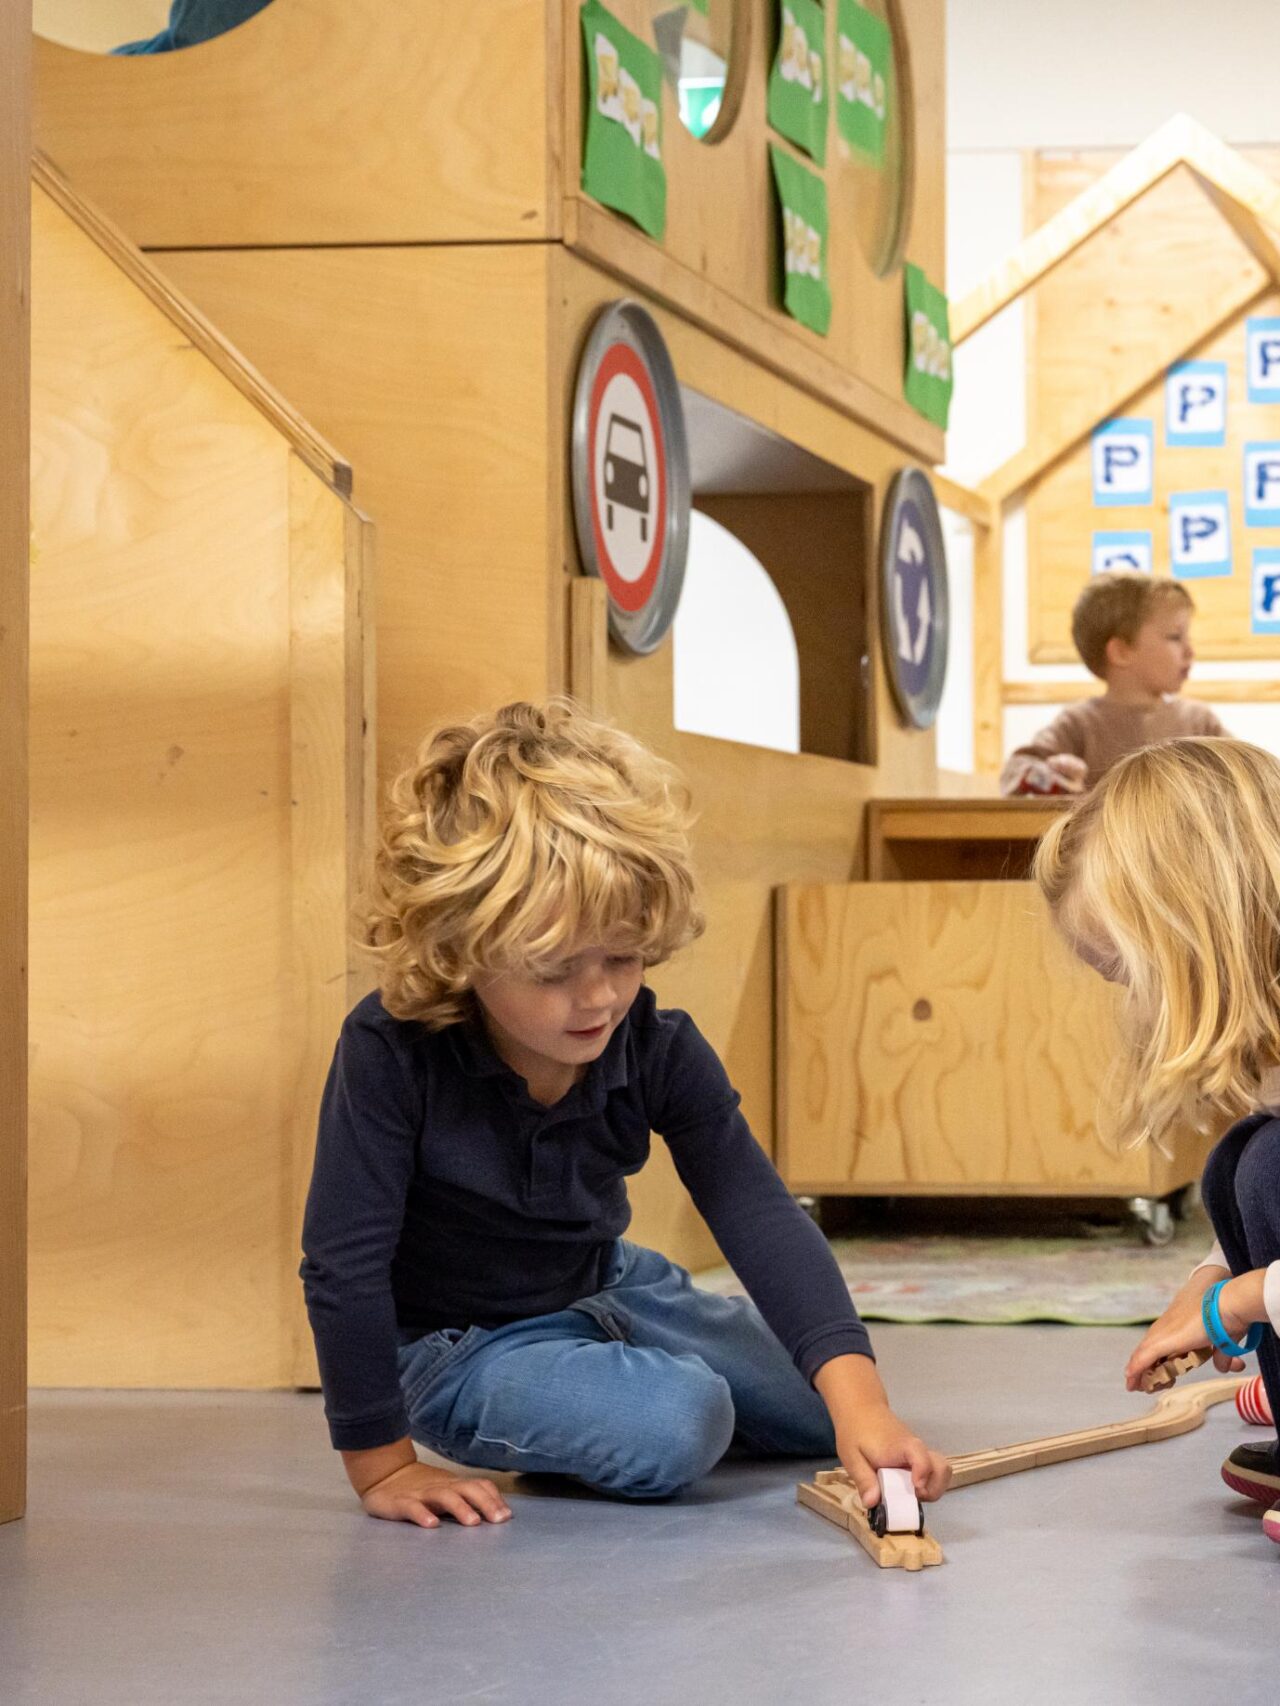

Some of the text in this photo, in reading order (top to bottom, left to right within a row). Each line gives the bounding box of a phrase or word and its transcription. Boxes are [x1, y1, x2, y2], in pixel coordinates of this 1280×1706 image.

[1180, 385, 1215, 422] P
[1104, 445, 1139, 484] P
[1182, 517, 1218, 552] P
